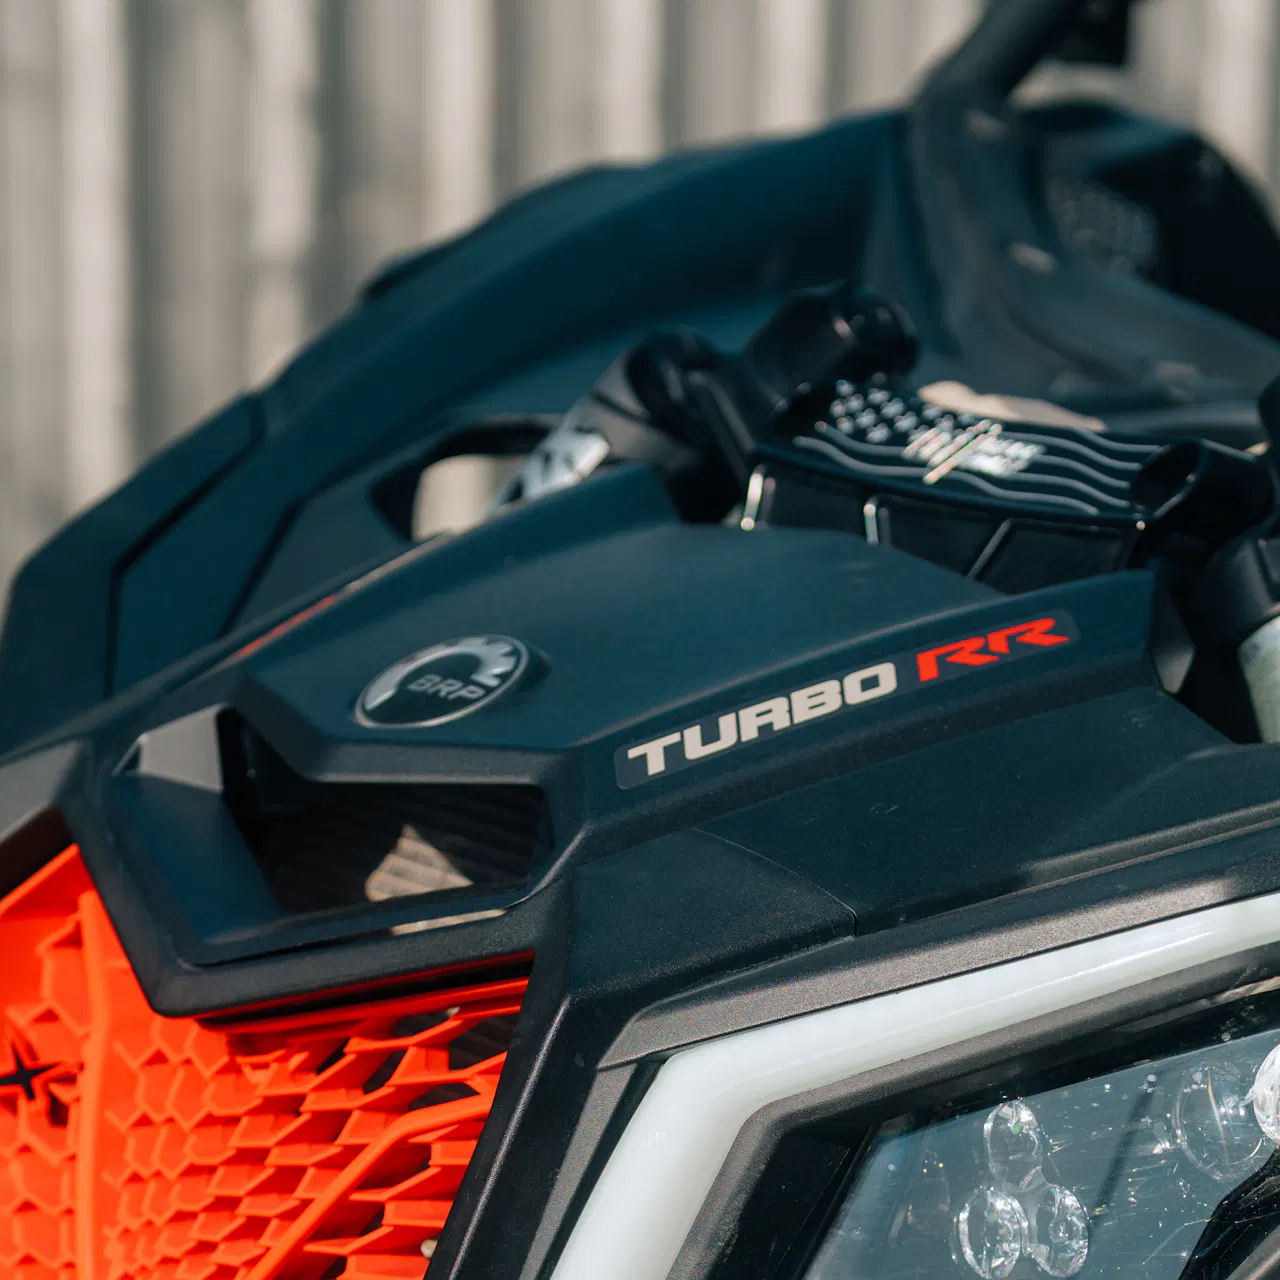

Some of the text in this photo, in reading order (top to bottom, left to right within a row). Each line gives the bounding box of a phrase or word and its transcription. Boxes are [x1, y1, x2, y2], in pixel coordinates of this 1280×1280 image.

[406, 673, 487, 700] BRP
[627, 617, 1070, 776] TURBO RR
